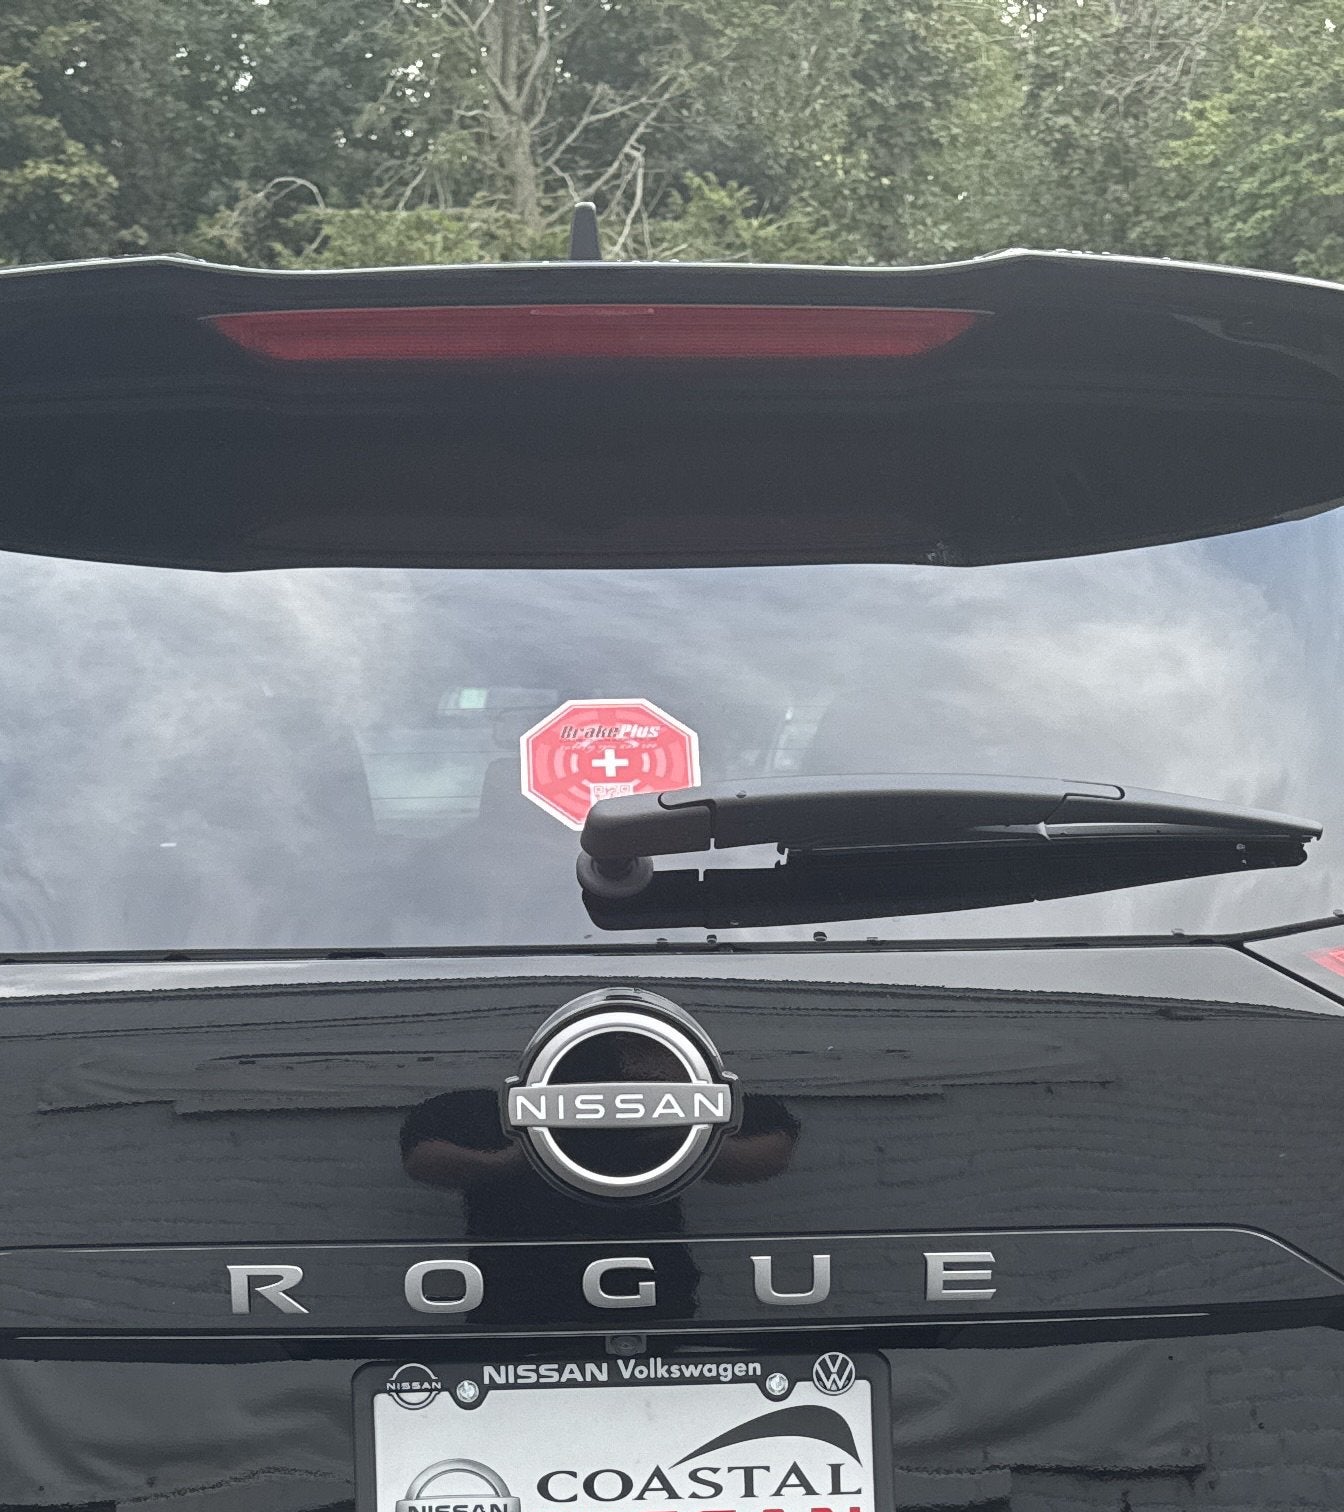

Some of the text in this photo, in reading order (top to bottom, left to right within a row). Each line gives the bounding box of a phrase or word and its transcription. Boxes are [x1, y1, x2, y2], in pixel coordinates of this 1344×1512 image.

[514, 1091, 726, 1121] NISSAN
[226, 1251, 998, 1316] ROGUE
[386, 1381, 442, 1391] NISSAN
[483, 1358, 762, 1384] NISSAN Volkswagen
[537, 1461, 862, 1502] COASTAL
